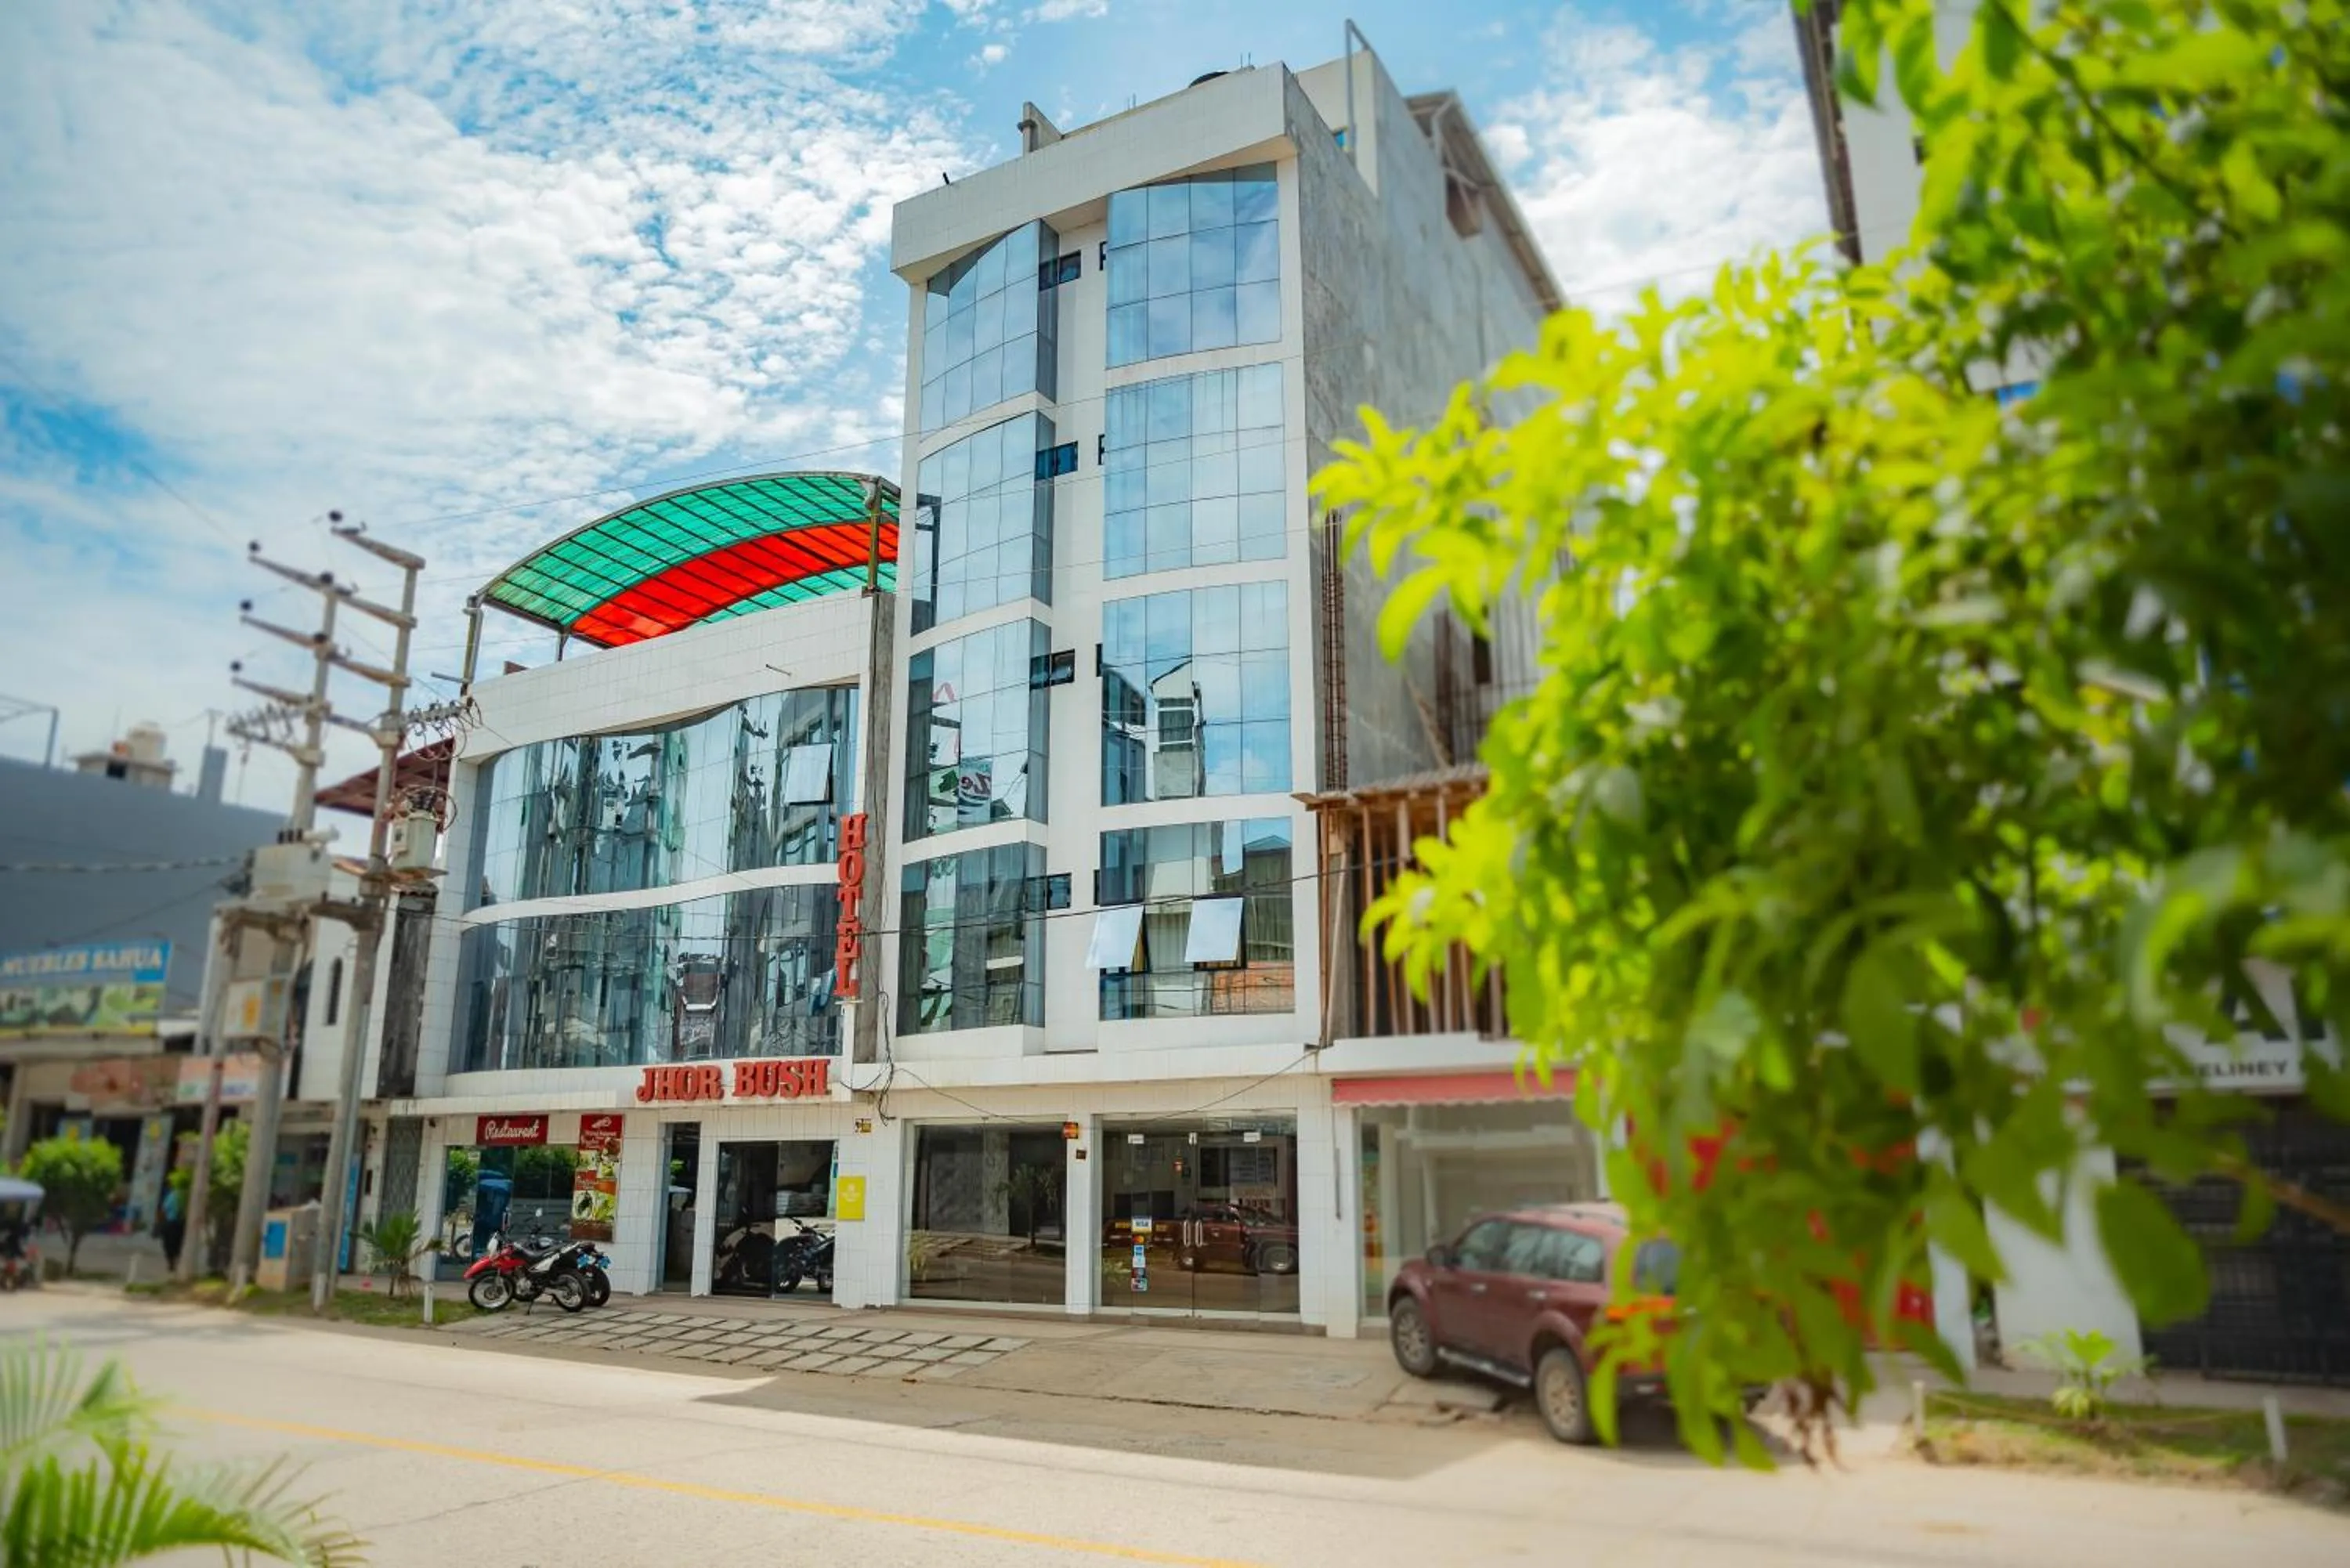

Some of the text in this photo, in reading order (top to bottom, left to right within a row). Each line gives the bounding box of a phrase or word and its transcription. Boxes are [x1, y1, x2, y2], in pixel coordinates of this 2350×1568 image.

[833, 813, 868, 999] HOTEL
[636, 1058, 832, 1103] JHOR BUSH
[484, 1118, 540, 1140] Restaurant
